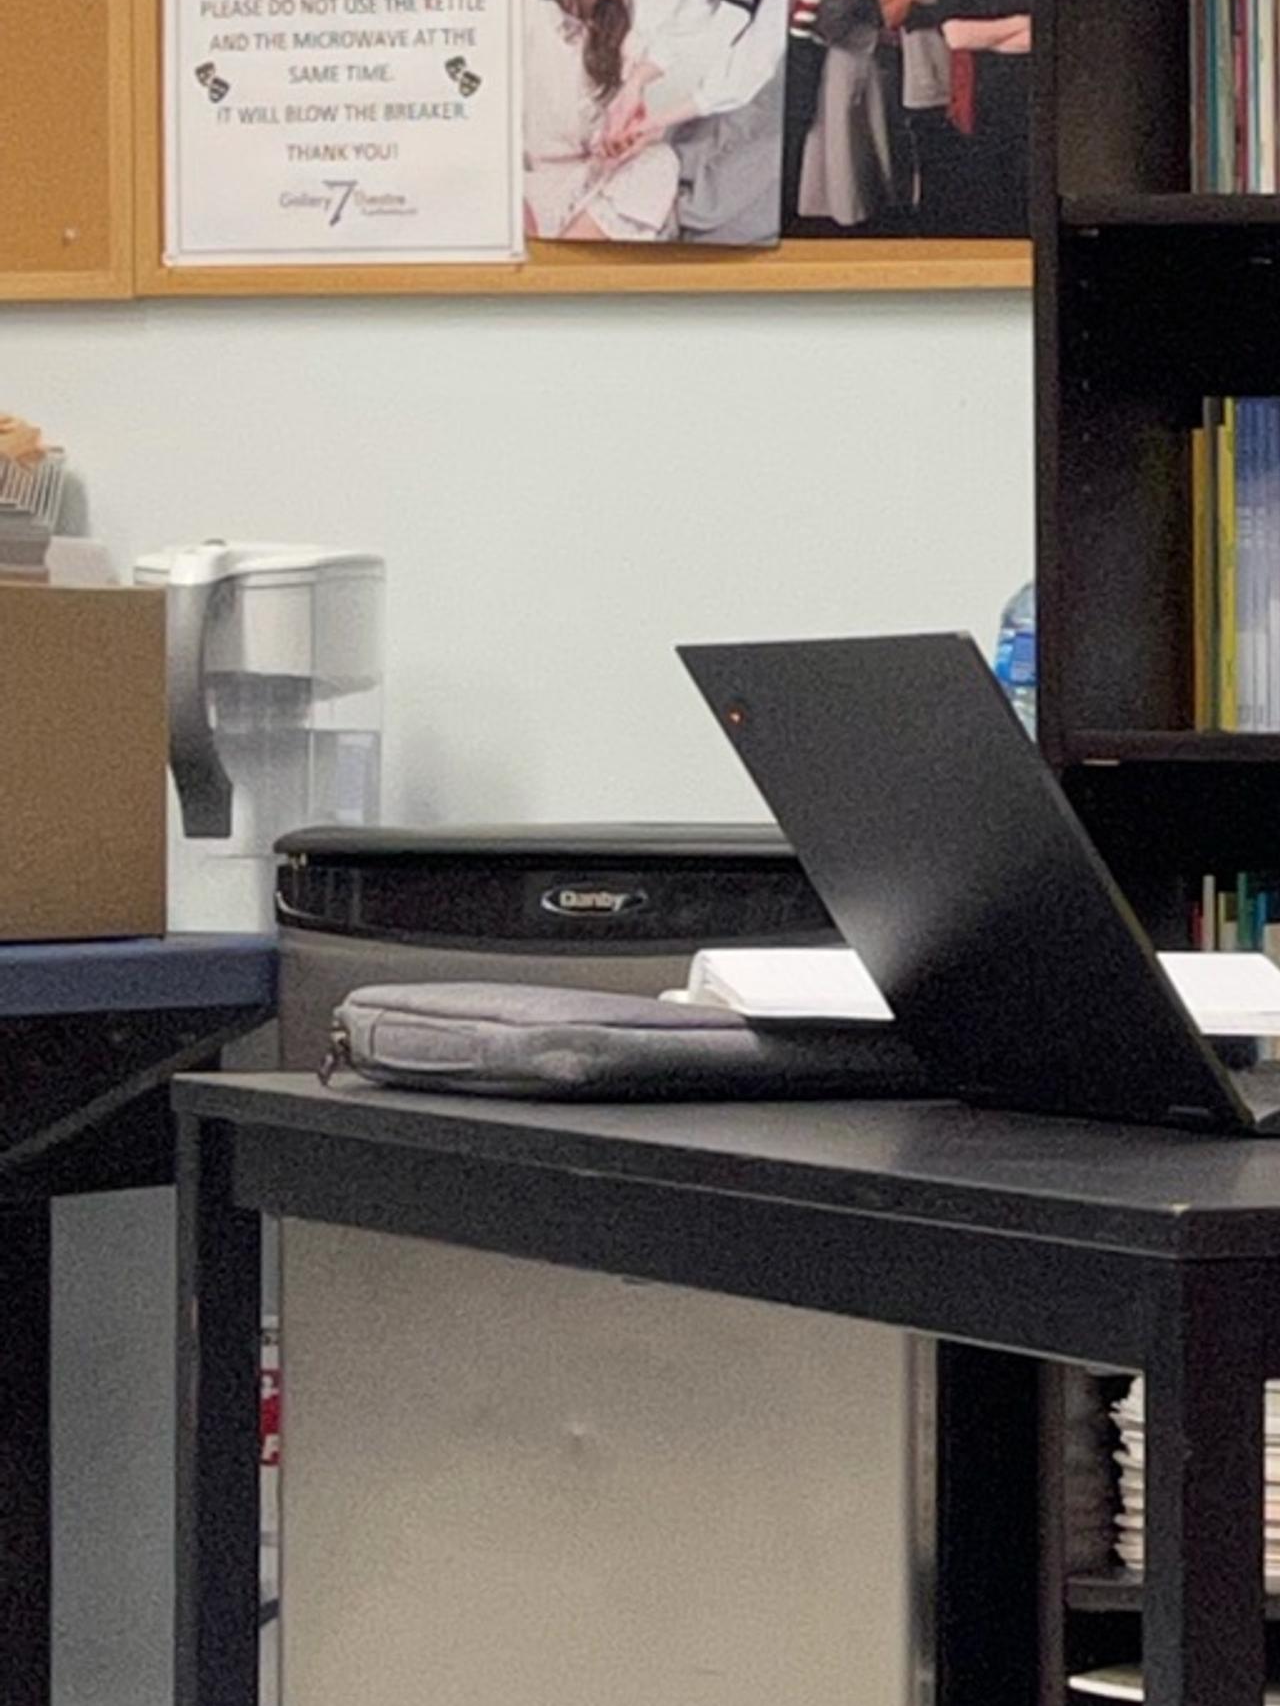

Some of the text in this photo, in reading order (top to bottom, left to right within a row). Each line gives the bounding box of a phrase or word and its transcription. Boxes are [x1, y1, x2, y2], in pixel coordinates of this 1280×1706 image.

[209, 27, 477, 52] AND THE MICROWAVE AT THE
[288, 63, 395, 85] SAME TIME.
[216, 102, 469, 125] IT WILL BLOW THE BREAKER.
[286, 141, 400, 163] THANK YOU!
[321, 179, 358, 227] 7
[557, 890, 630, 914] Danby
